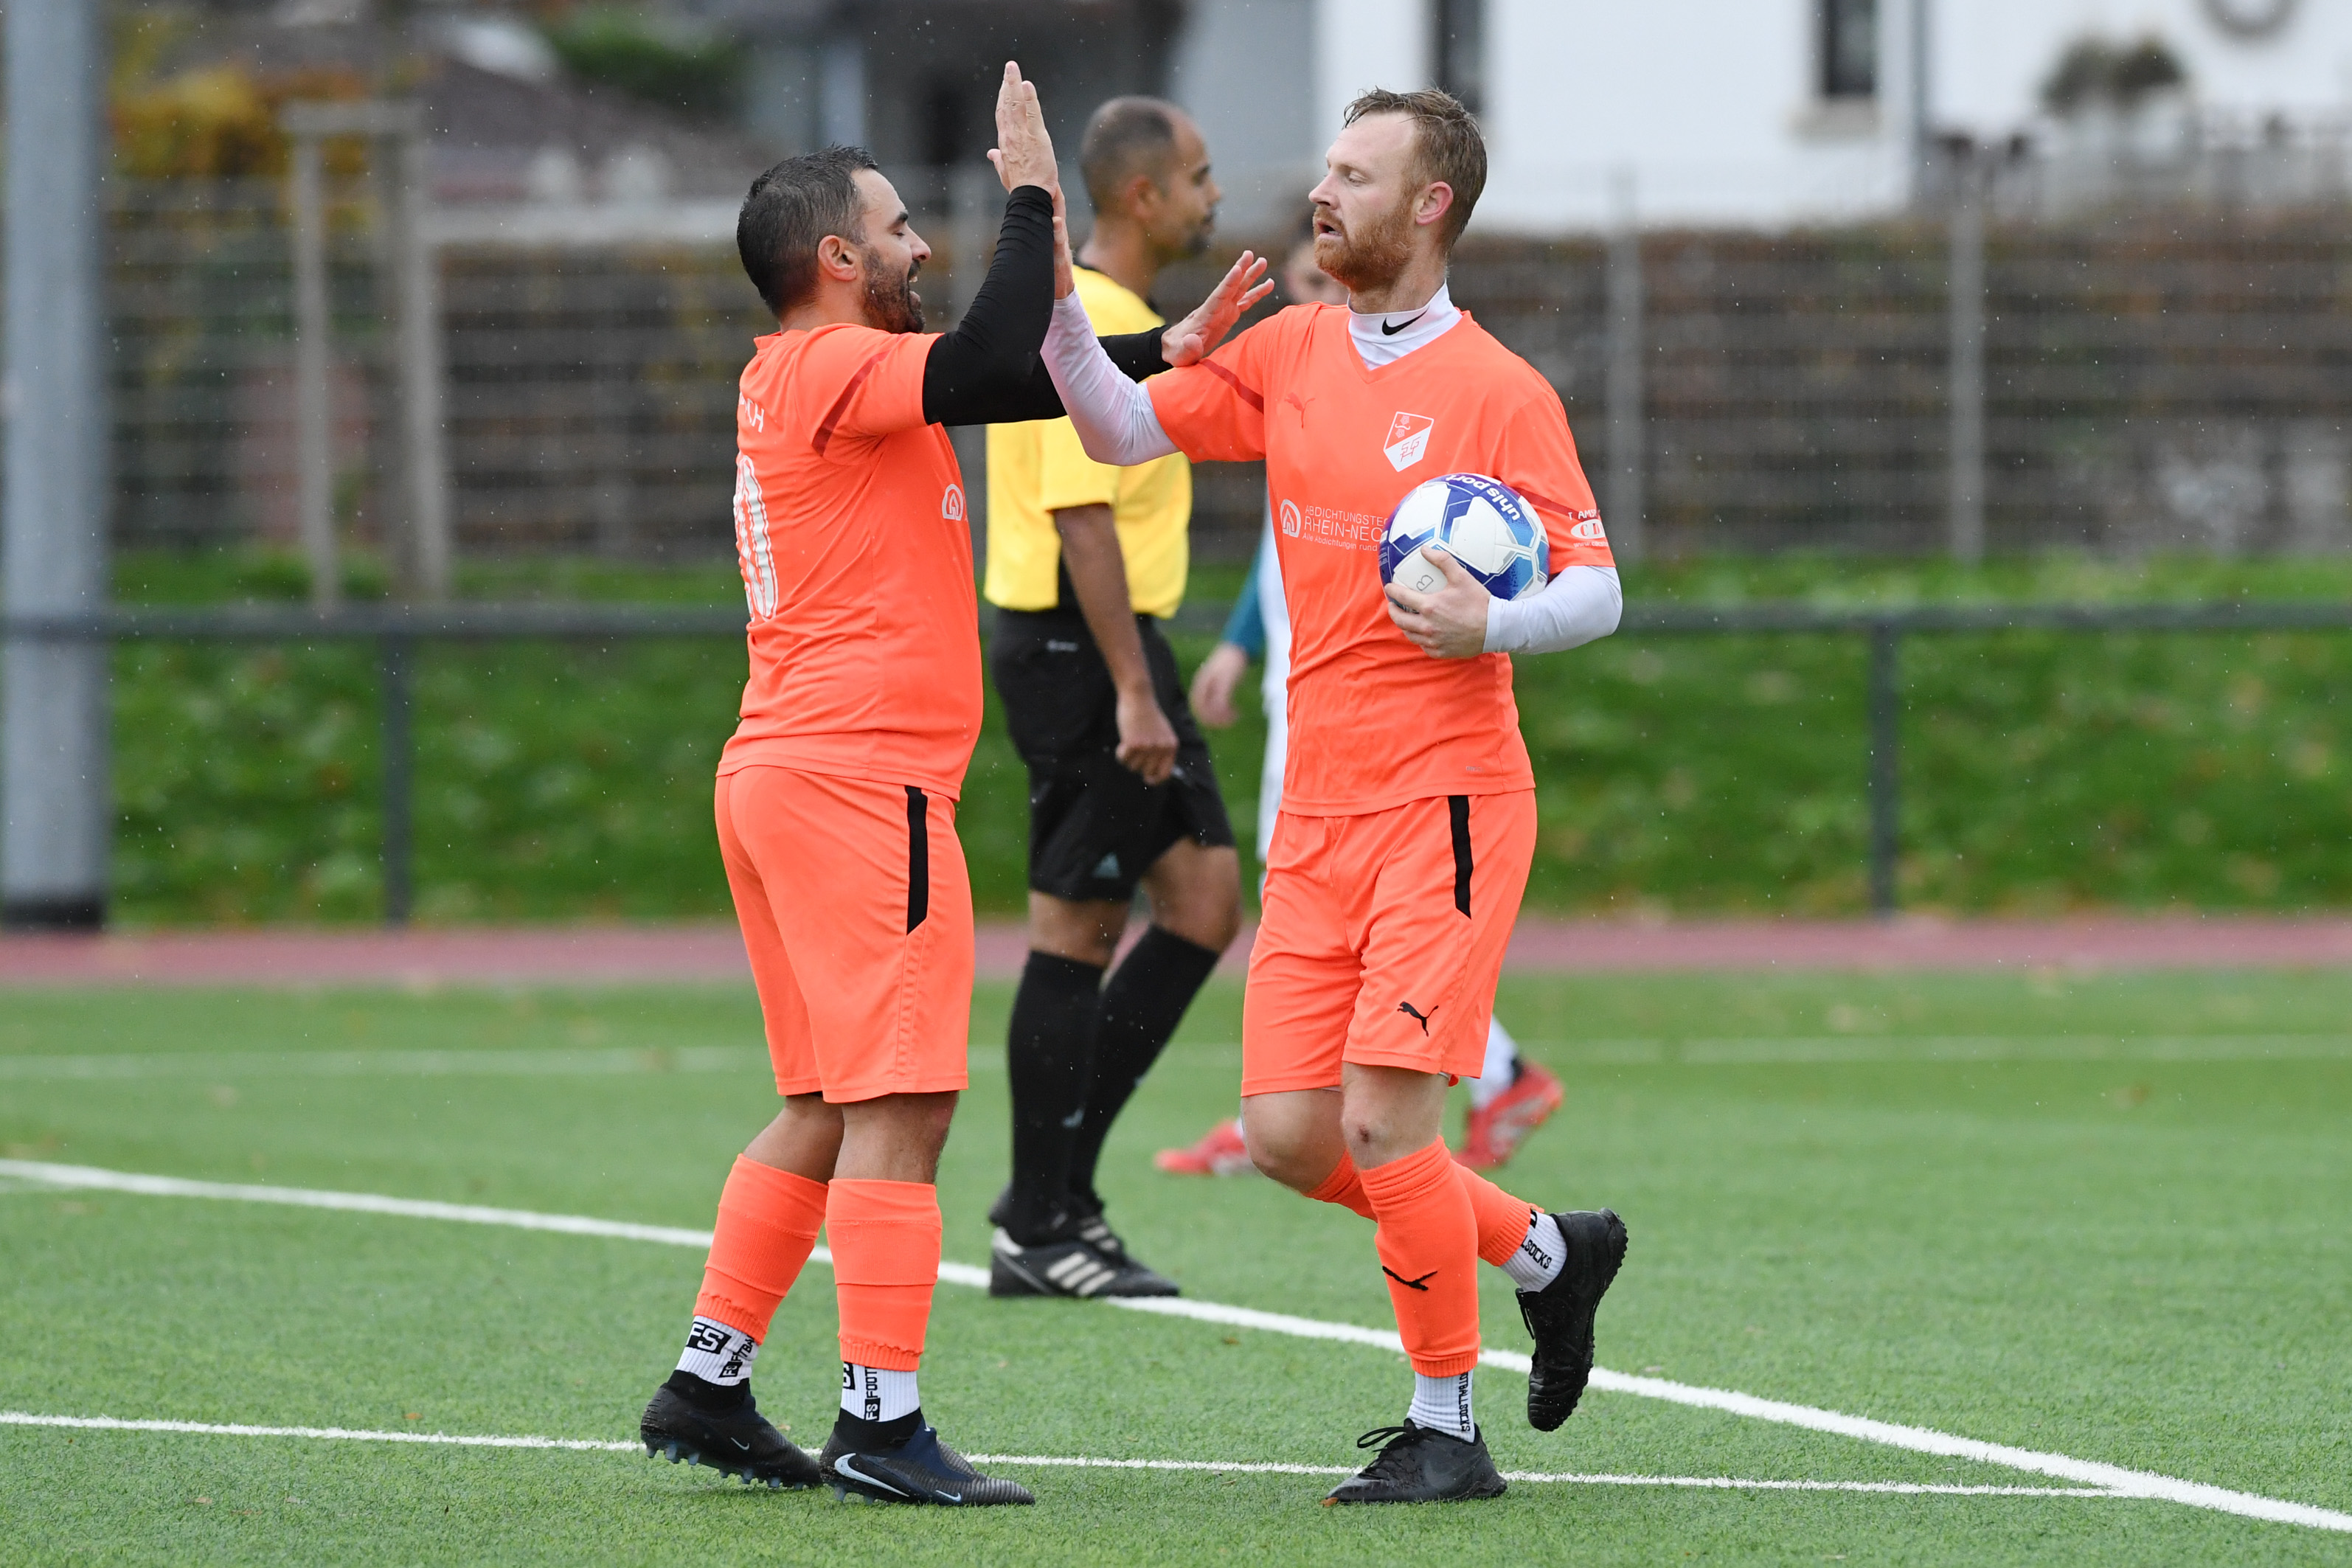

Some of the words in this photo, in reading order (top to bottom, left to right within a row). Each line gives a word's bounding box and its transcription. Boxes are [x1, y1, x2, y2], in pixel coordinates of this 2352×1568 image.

[1446, 474, 1521, 521] uhlsport
[1314, 534, 1357, 550] Abdichtungen
[1359, 544, 1378, 552] rund
[687, 1323, 724, 1351] FS
[865, 1404, 878, 1420] FS
